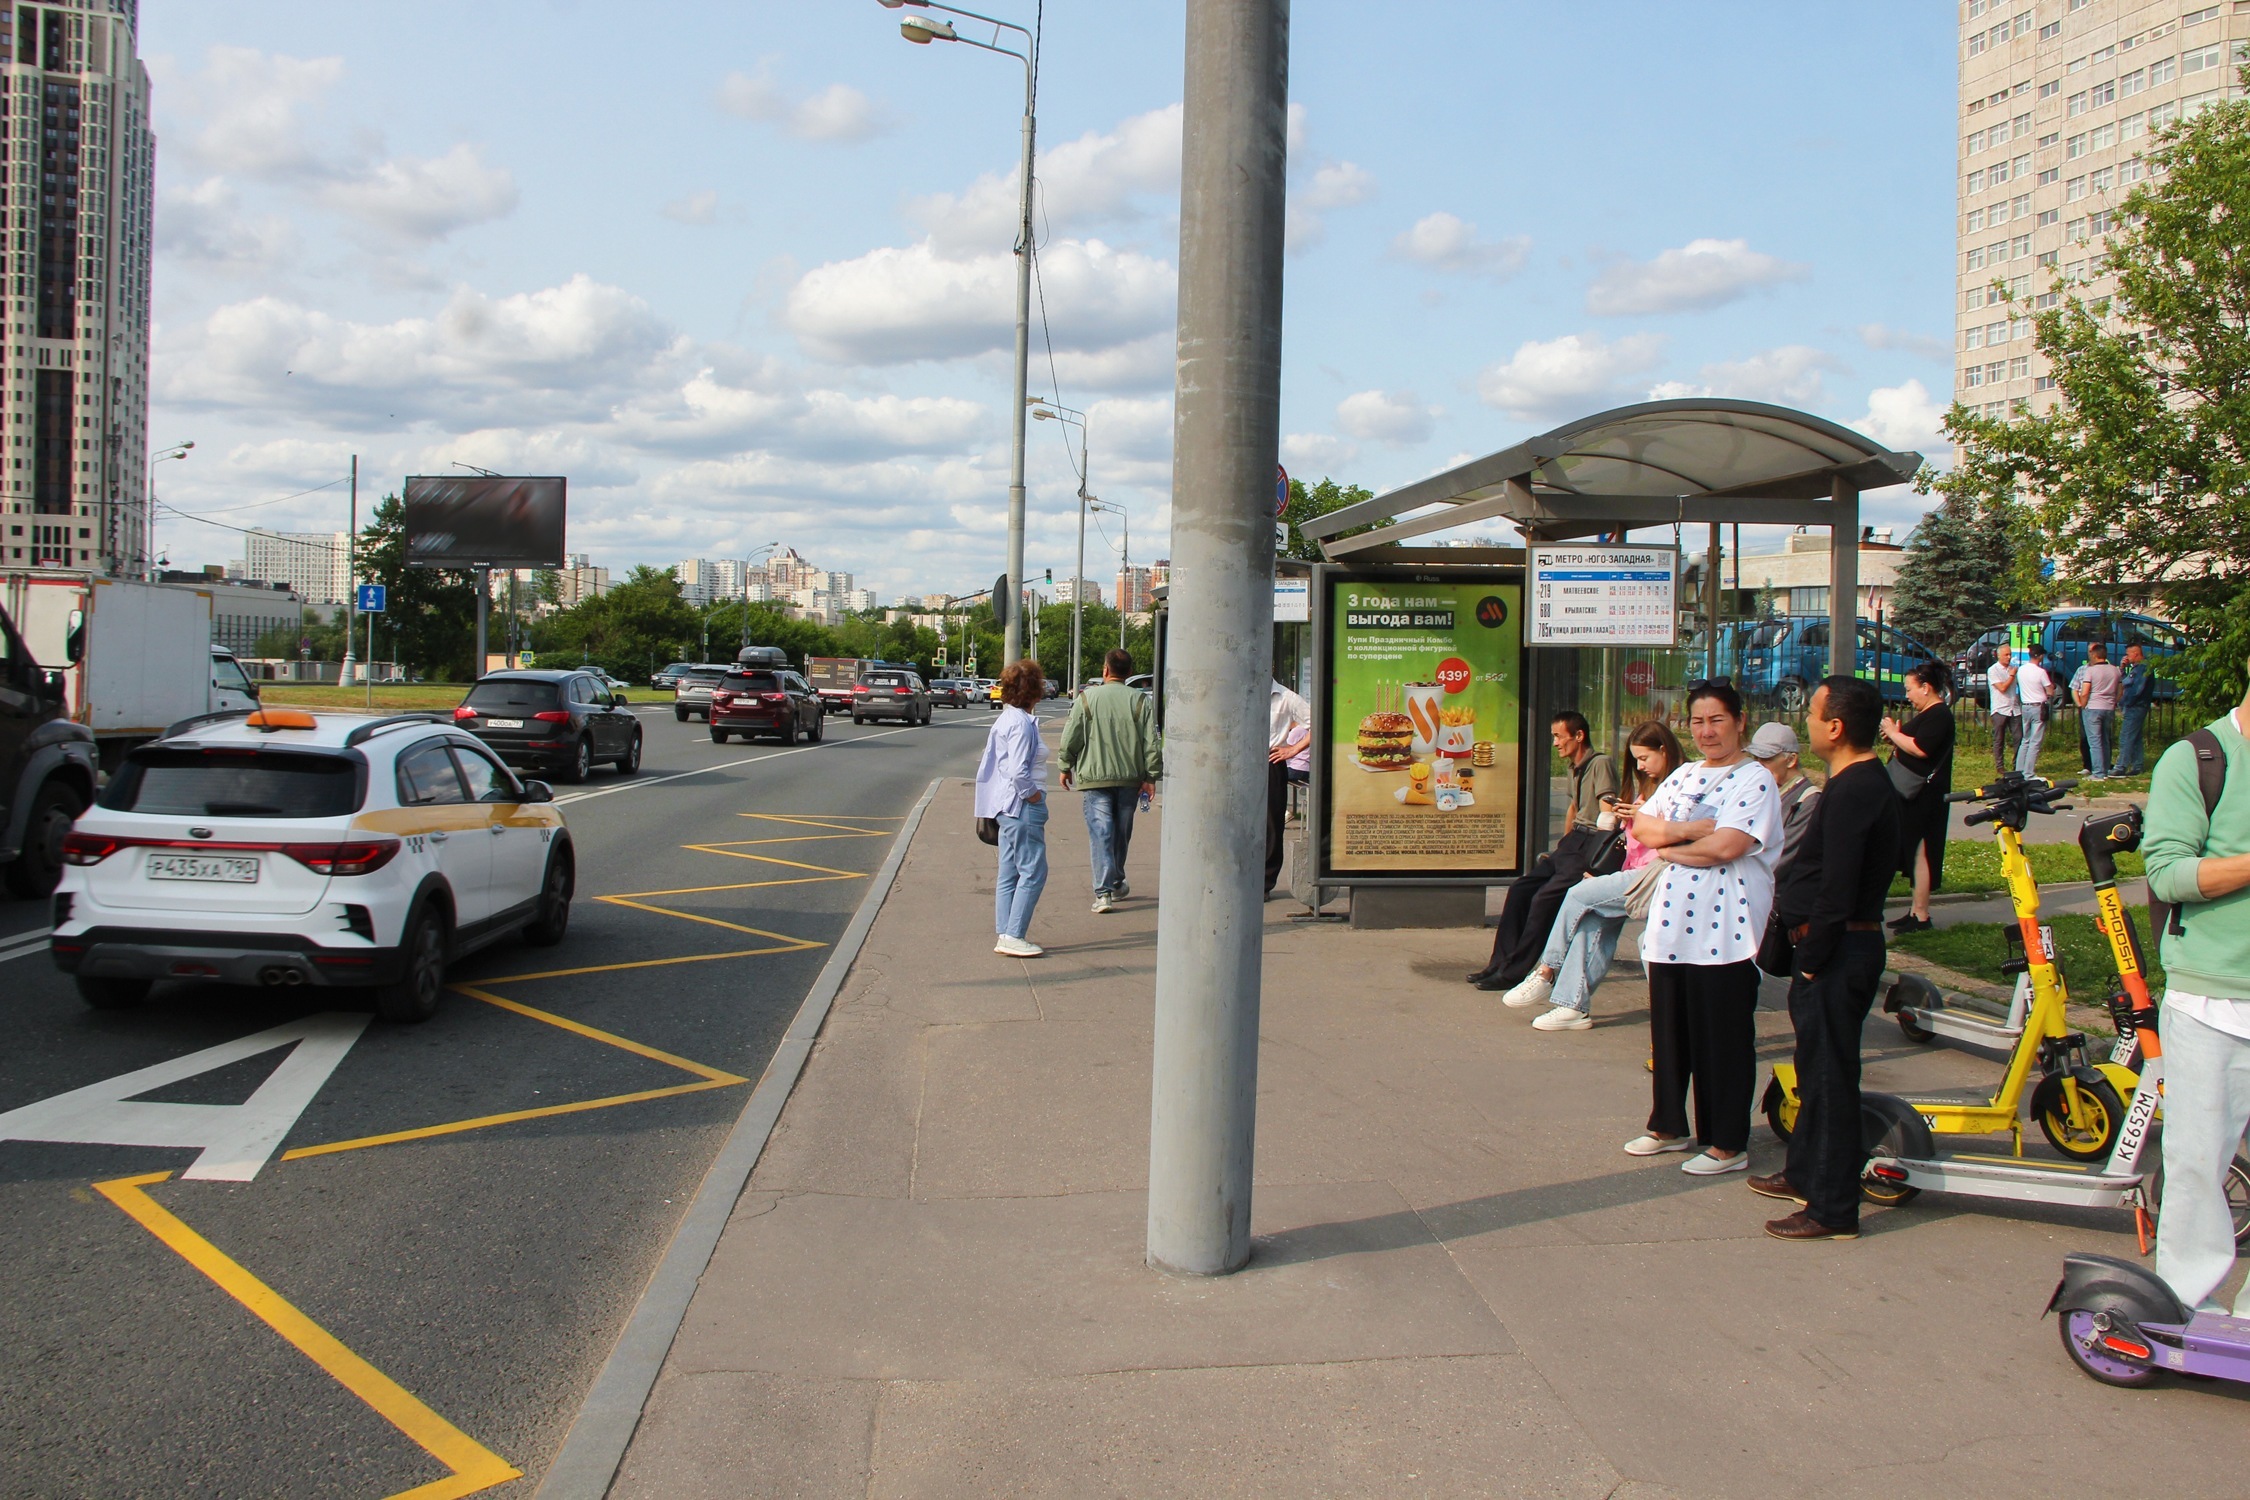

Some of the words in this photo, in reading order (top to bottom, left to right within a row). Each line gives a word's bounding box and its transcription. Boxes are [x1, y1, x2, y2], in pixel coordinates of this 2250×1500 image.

[1555, 554, 1582, 564] МЕТРО
[1540, 584, 1550, 598] 219
[1348, 594, 1358, 606] 3
[1363, 596, 1400, 610] года
[1404, 597, 1438, 607] нам
[1348, 613, 1410, 626] выгода
[1414, 612, 1452, 625] вам!
[1369, 636, 1424, 644] Праздничный
[1418, 644, 1457, 652] фигуркой
[154, 858, 220, 877] Р435ХА
[225, 860, 254, 874] 790
[2104, 894, 2135, 970] WHOOSH
[2116, 1092, 2154, 1161] KE652M
